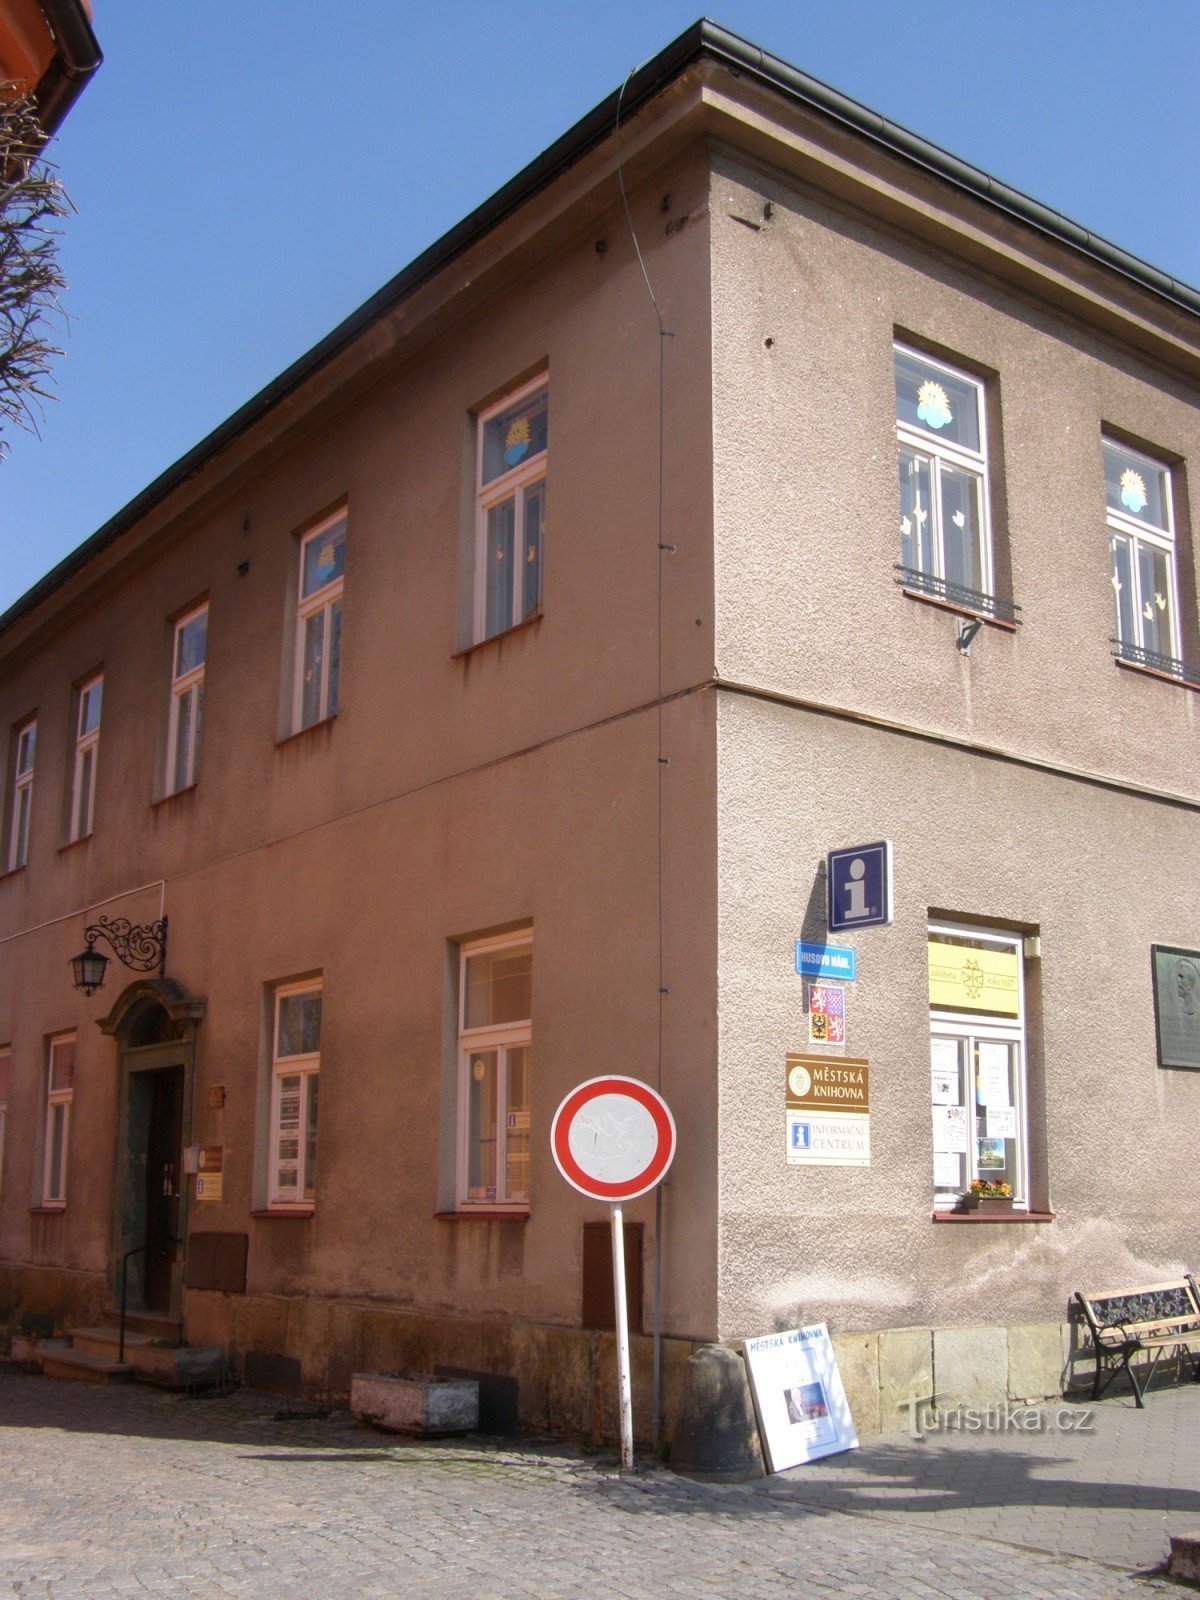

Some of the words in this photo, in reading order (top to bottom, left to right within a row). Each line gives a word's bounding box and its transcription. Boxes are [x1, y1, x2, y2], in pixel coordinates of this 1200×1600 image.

[801, 952, 830, 966] HUSOVO
[813, 1066, 864, 1084] MĚSTSKÁ
[813, 1085, 864, 1100] KNIHOVNA
[813, 1123, 864, 1136] INFORMAČNÍ
[813, 1138, 864, 1151] CENTRUM
[750, 1334, 784, 1352] MĚSTSKÁ
[788, 1328, 823, 1344] KNIHOVNA
